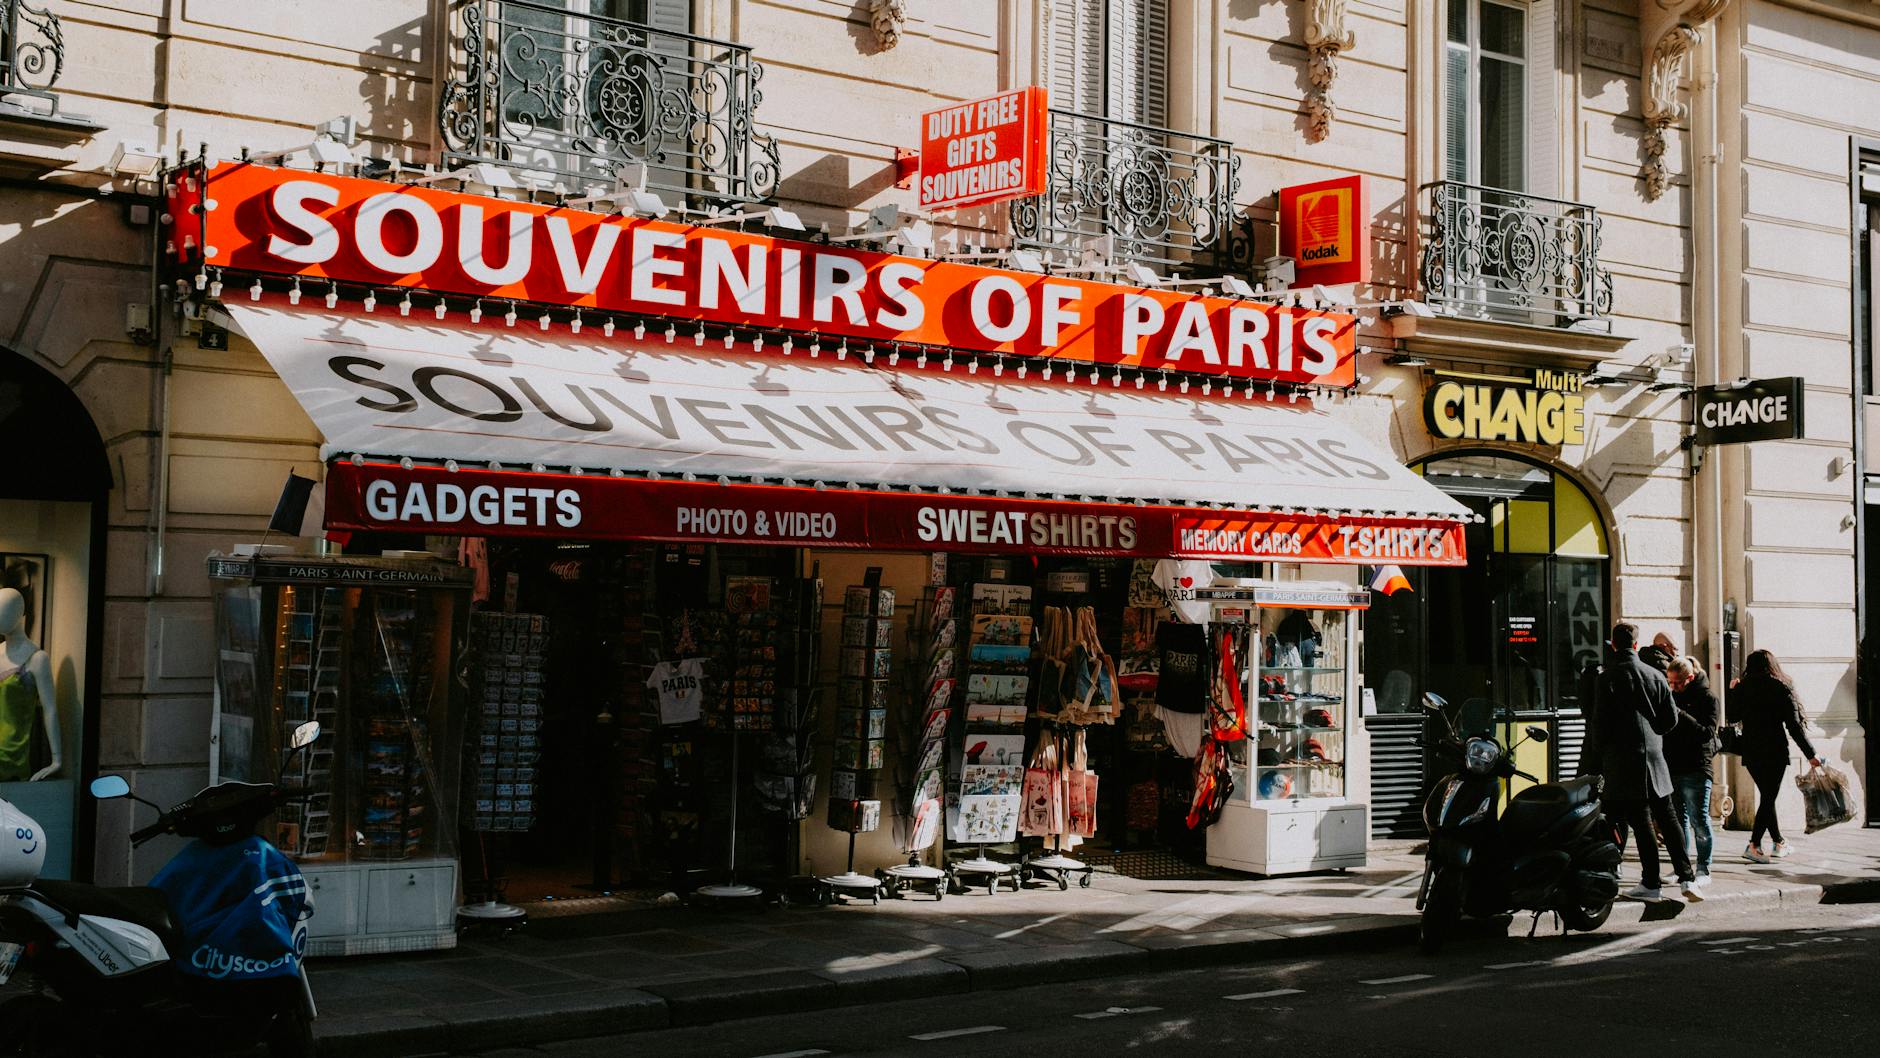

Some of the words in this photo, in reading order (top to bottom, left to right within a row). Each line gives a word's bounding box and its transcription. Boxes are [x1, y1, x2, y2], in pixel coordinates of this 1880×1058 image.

[928, 104, 975, 141] DUTY
[978, 93, 1019, 133] FREE
[947, 131, 997, 168] GIFTS
[922, 157, 1022, 204] SOUVENIRS
[1301, 244, 1340, 261] Kodak
[267, 180, 927, 332] SOUVENIRS
[970, 275, 1083, 347] OF
[1121, 293, 1339, 377] PARIS
[208, 333, 218, 347] 4
[1535, 369, 1583, 393] Multi
[328, 355, 999, 456] SOUVENIRS
[1007, 419, 1135, 467] OF
[1146, 428, 1390, 480] PARIS
[1432, 381, 1585, 445] CHANGE
[1701, 395, 1788, 429] CHANGE
[366, 479, 582, 528] GADGETS
[676, 506, 748, 536] PHOTO
[754, 510, 770, 536] &
[775, 511, 837, 539] VIDEO
[1180, 528, 1247, 553] MEMORY
[1251, 531, 1302, 555] CARDS
[1339, 525, 1445, 558] T-SHIRTS
[288, 567, 329, 579] PARIS
[334, 568, 445, 583] SAINT-GERMAIN
[1172, 577, 1180, 589] I
[1272, 592, 1295, 600] PARIS
[1166, 650, 1199, 666] PARIS
[661, 675, 697, 693] PARIS
[98, 950, 119, 973] Uber
